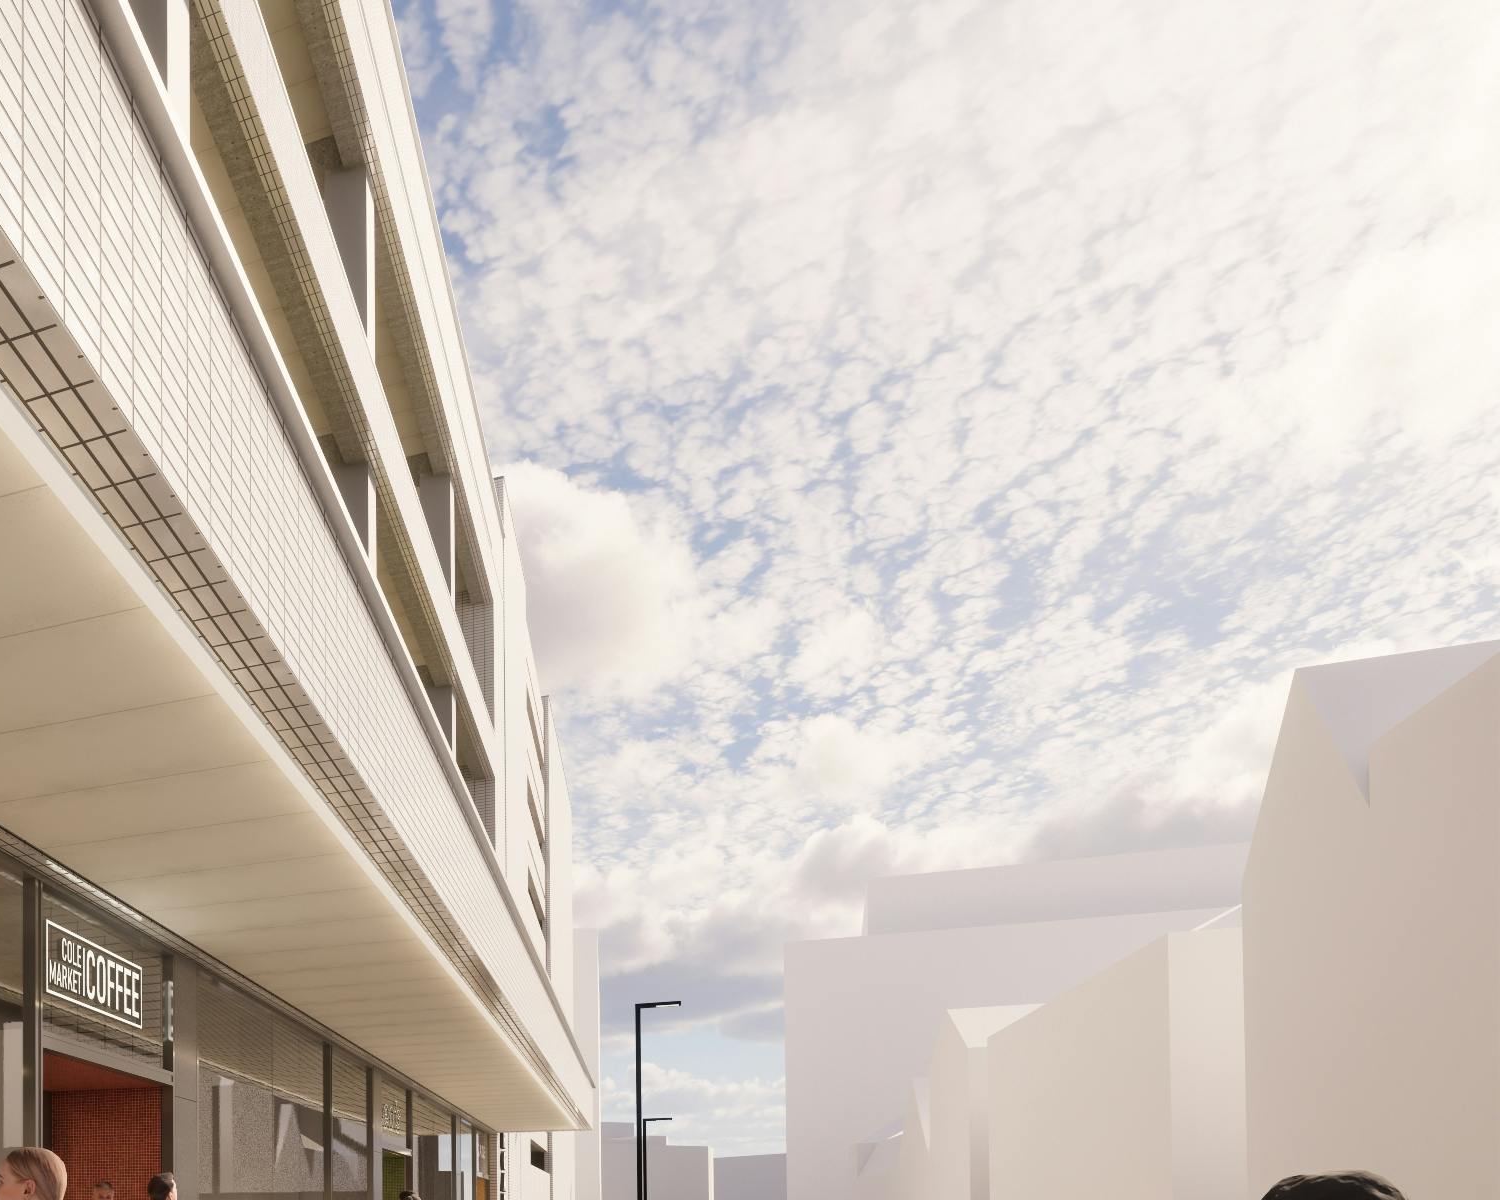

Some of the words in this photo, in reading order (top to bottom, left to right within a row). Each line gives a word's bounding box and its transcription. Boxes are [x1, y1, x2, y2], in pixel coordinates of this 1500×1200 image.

[61, 938, 82, 968] COLE
[49, 959, 82, 995] MARKET
[86, 949, 140, 1019] COFFEE
